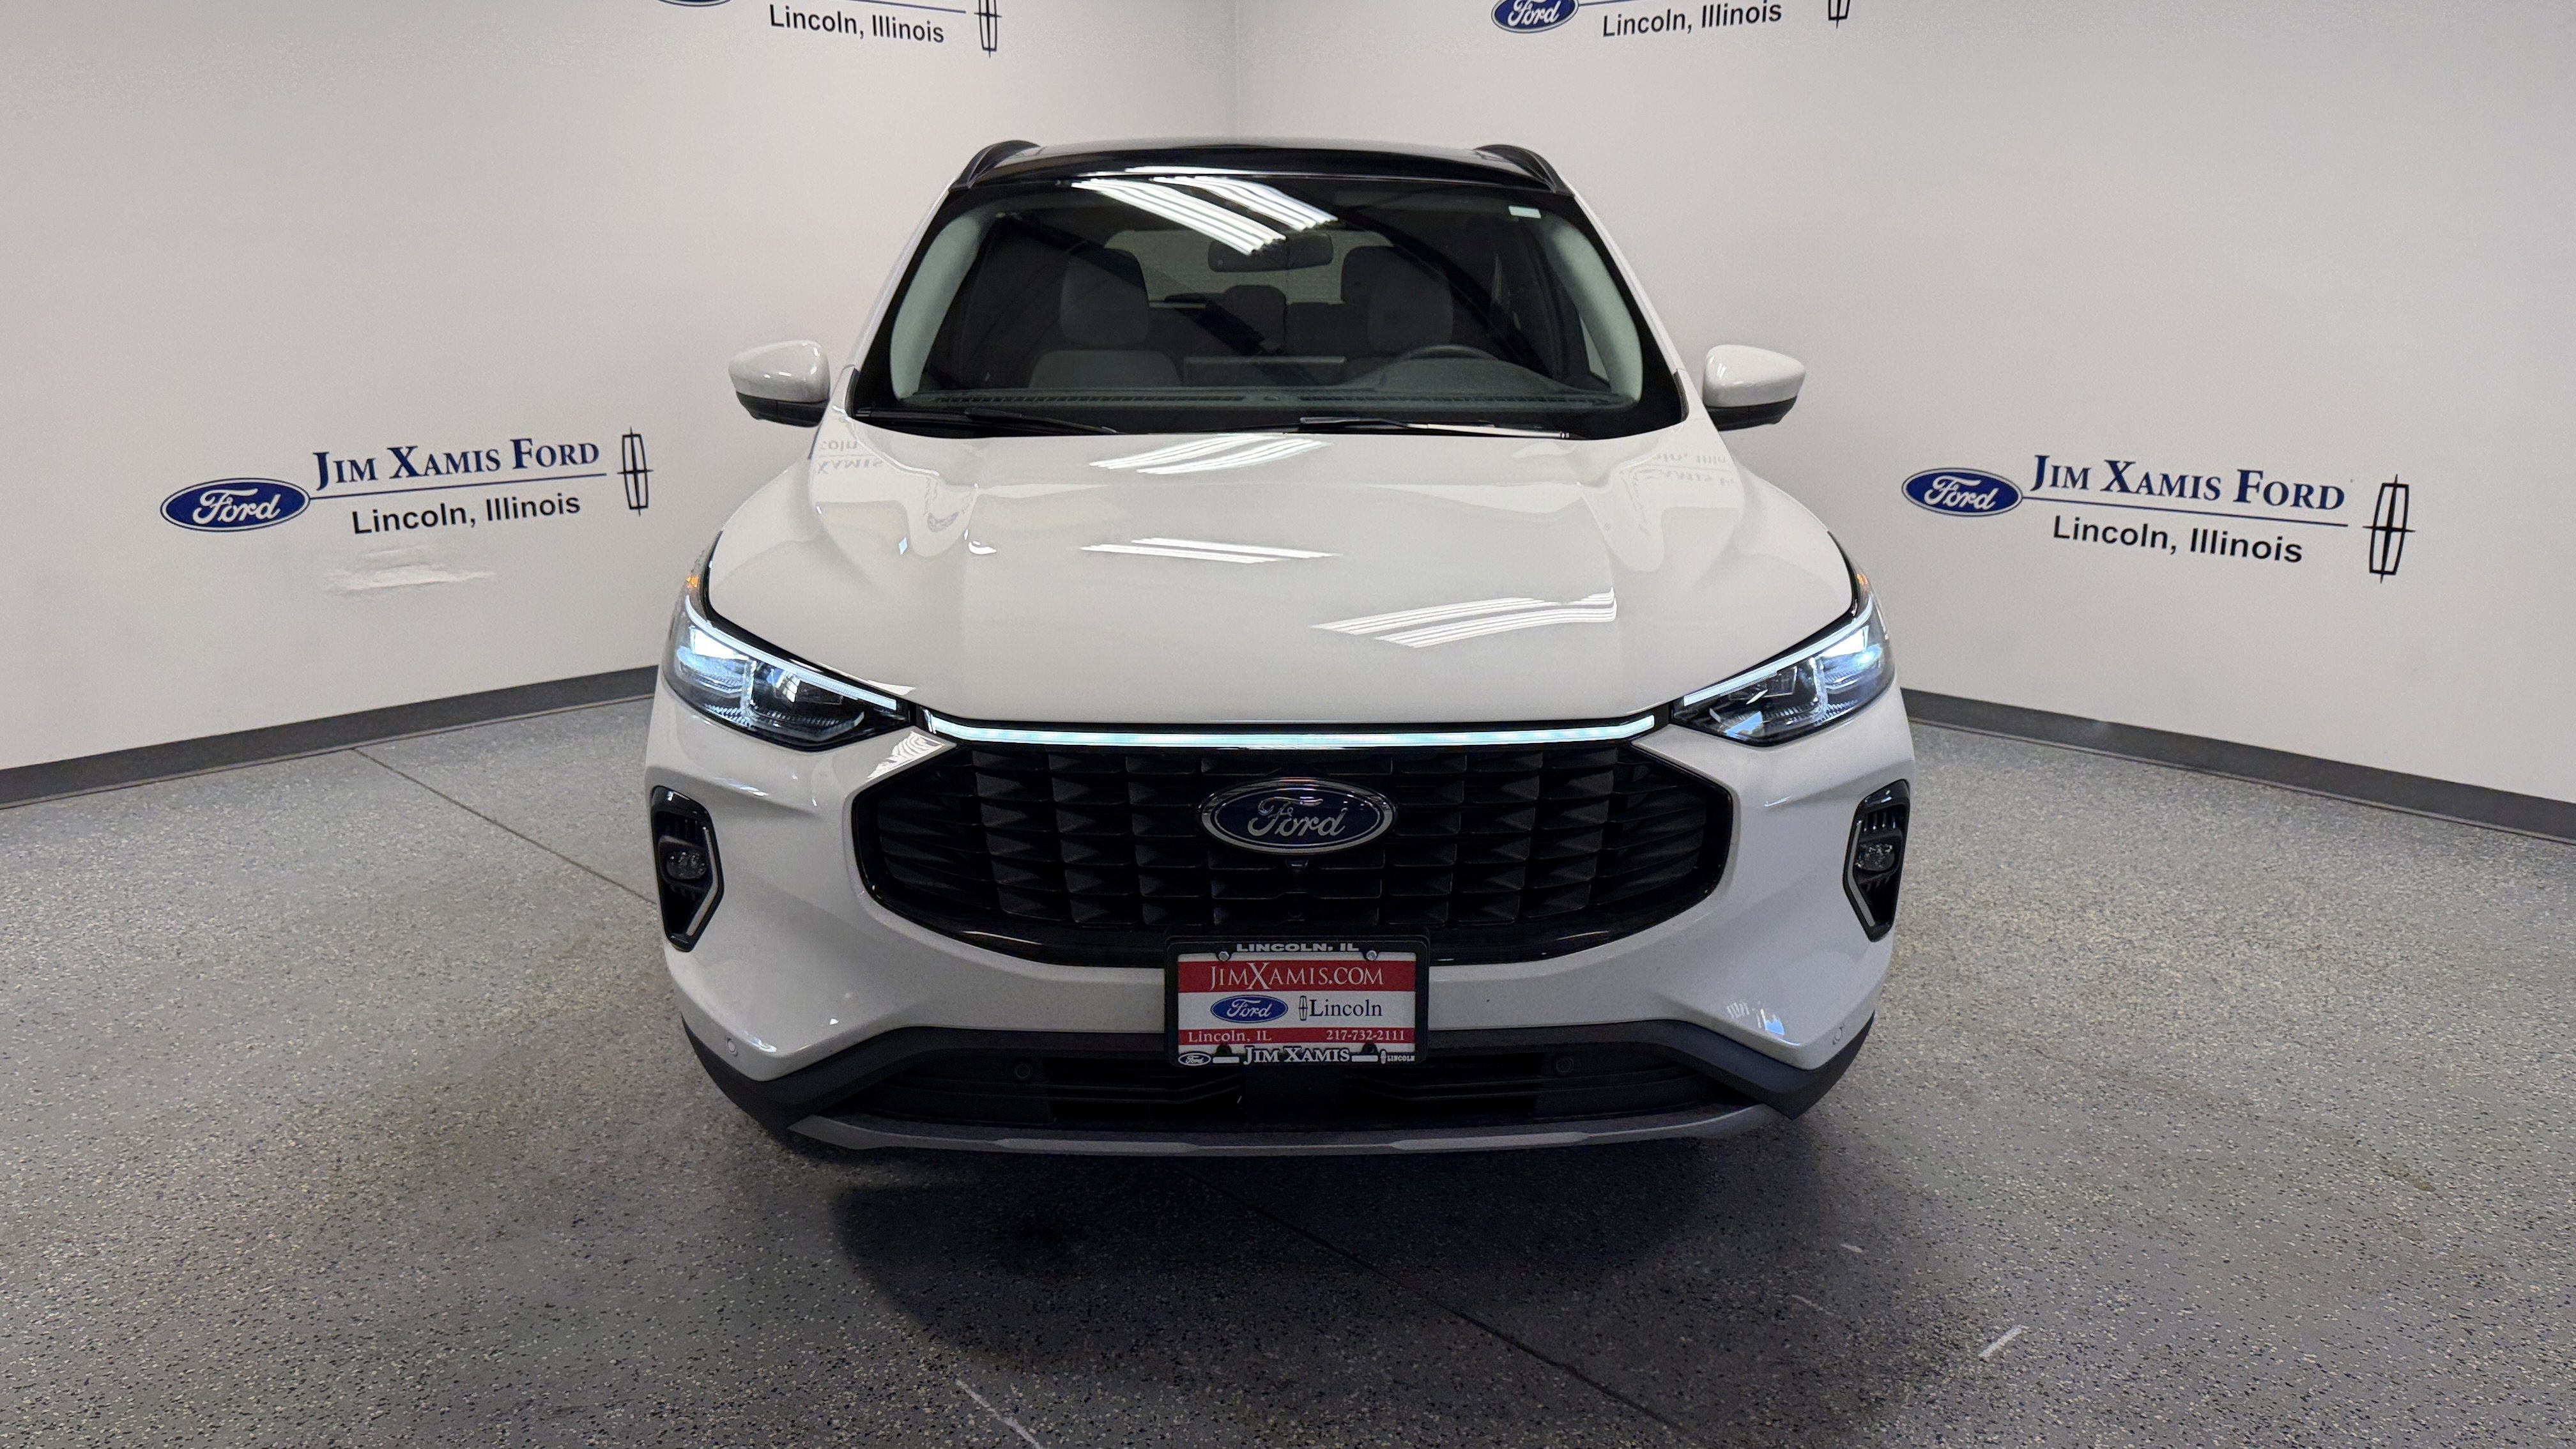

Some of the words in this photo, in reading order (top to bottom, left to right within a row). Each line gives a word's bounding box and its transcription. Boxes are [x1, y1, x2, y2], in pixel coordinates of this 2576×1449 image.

[769, 4, 864, 40] Lincoln,
[872, 14, 945, 43] Illinois
[1508, 0, 1561, 27] Ford
[1603, 8, 1692, 37] Lincoln,
[1701, 0, 1782, 28] Illinois
[312, 451, 378, 491] JIM
[387, 445, 502, 479] XAMIS
[509, 438, 600, 470] FORD
[1924, 475, 1999, 510] Ford
[2030, 454, 2091, 492] JIM
[2099, 459, 2221, 501] XAMIS
[2232, 468, 2345, 510] FORD
[192, 488, 281, 525] Ford
[352, 503, 477, 535] Lincoln,
[486, 492, 581, 521] Illinois
[2053, 515, 2177, 555] Lincoln,
[2190, 528, 2303, 563] Illinois
[1247, 796, 1348, 837] Ford
[1340, 943, 1360, 951] IL
[1209, 962, 1384, 991] JIMXAMIS.COM
[1226, 999, 1273, 1018] Ford
[1308, 999, 1383, 1017] Lincoln
[1188, 1030, 1250, 1043] Lincoln,
[1256, 1030, 1272, 1041] IL
[1326, 1029, 1406, 1041] 217-732-2111
[1185, 1055, 1205, 1064] Ford
[1243, 1046, 1280, 1065] JIM
[1284, 1047, 1351, 1063] XAMIS
